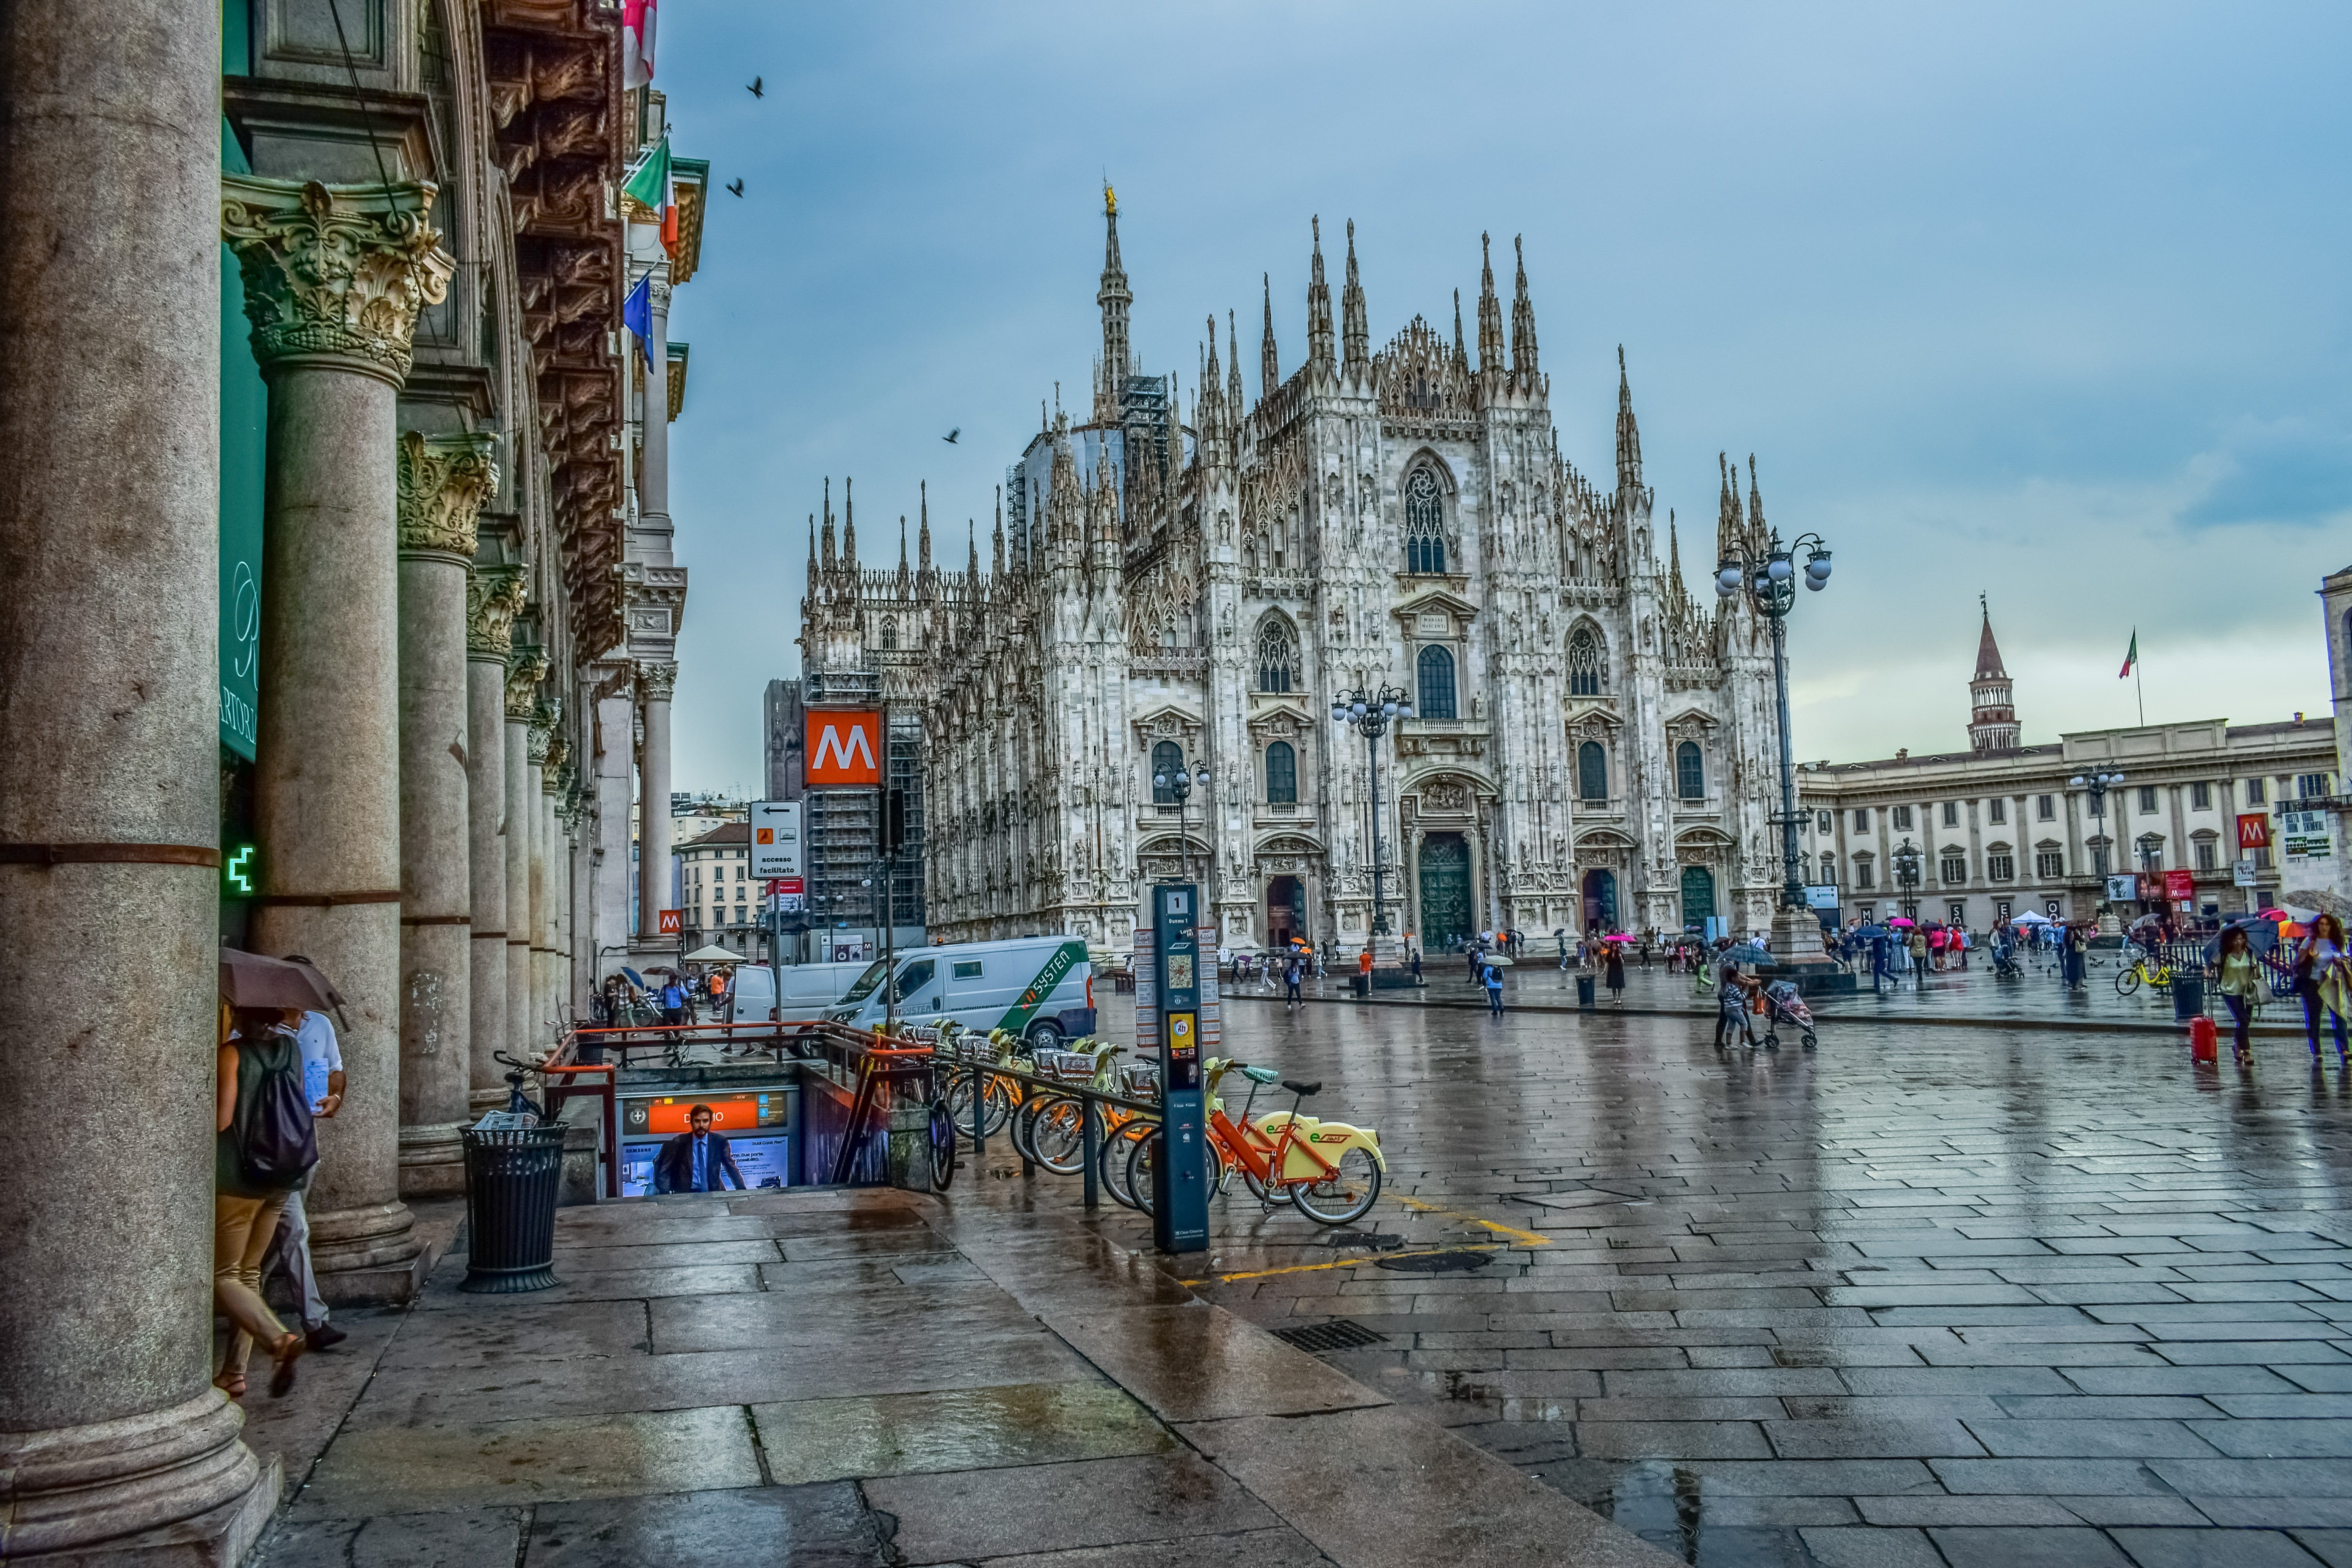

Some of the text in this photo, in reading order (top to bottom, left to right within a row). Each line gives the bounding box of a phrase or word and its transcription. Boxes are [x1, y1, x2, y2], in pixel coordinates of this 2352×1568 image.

[812, 725, 876, 769] M
[2243, 822, 2263, 841] M
[1174, 897, 1180, 908] 1
[662, 915, 680, 928] M
